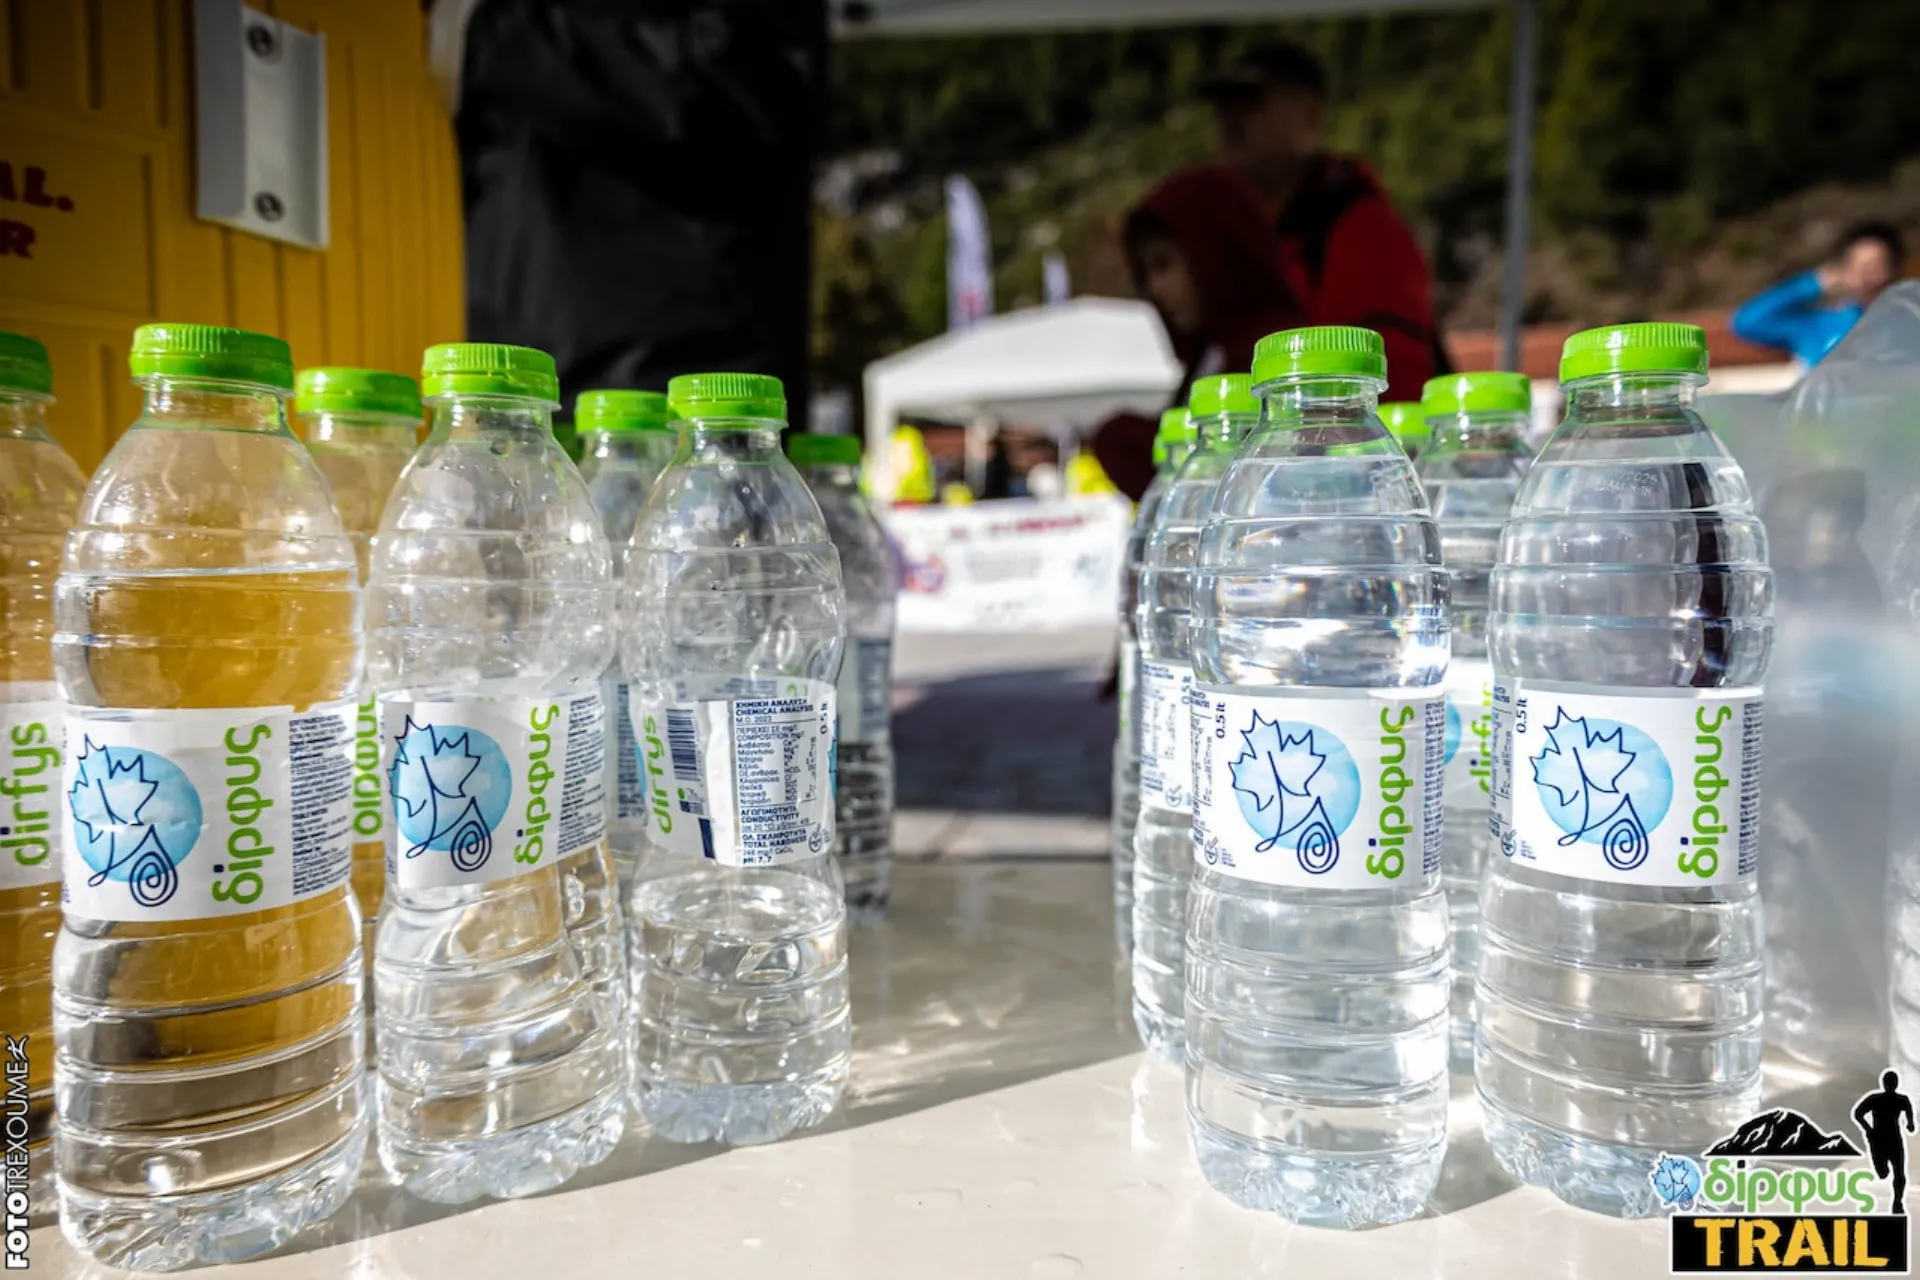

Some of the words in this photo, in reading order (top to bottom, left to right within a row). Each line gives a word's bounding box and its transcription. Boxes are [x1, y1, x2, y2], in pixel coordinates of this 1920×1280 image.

[736, 707, 777, 716] CHEMICAL
[779, 704, 813, 713] ANALYSIS
[741, 813, 799, 823] CONDUCTIVITY
[743, 840, 768, 848] TOTAL
[769, 835, 807, 846] HARDNESS
